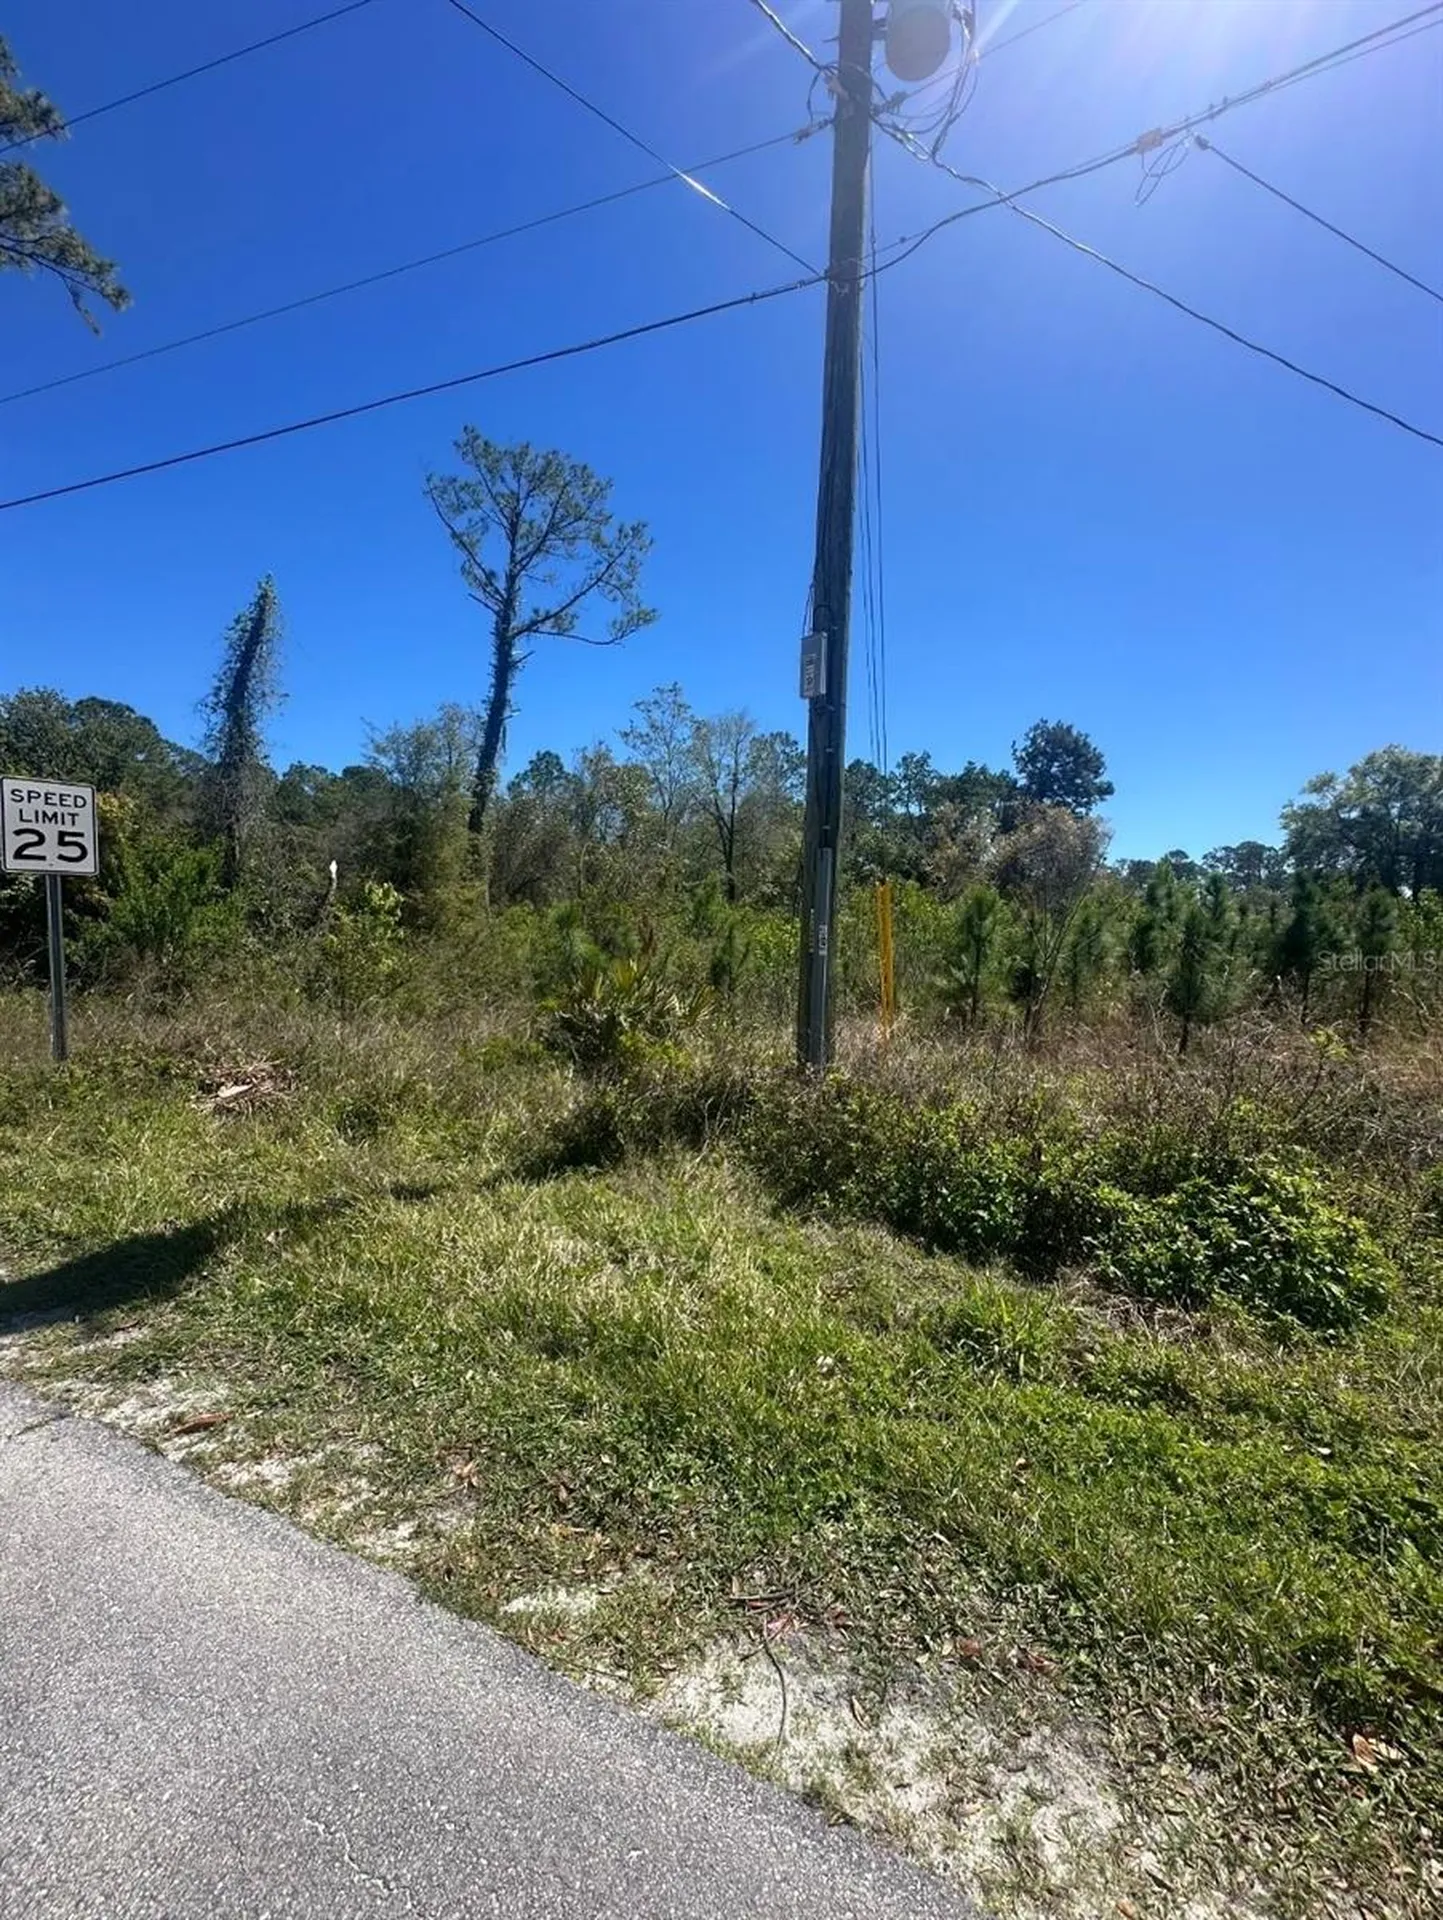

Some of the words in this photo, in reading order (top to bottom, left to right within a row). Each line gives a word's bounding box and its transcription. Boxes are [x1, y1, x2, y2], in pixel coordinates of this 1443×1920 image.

[10, 788, 87, 809] SPEED
[19, 808, 80, 827] LIMIT
[12, 828, 88, 863] 25
